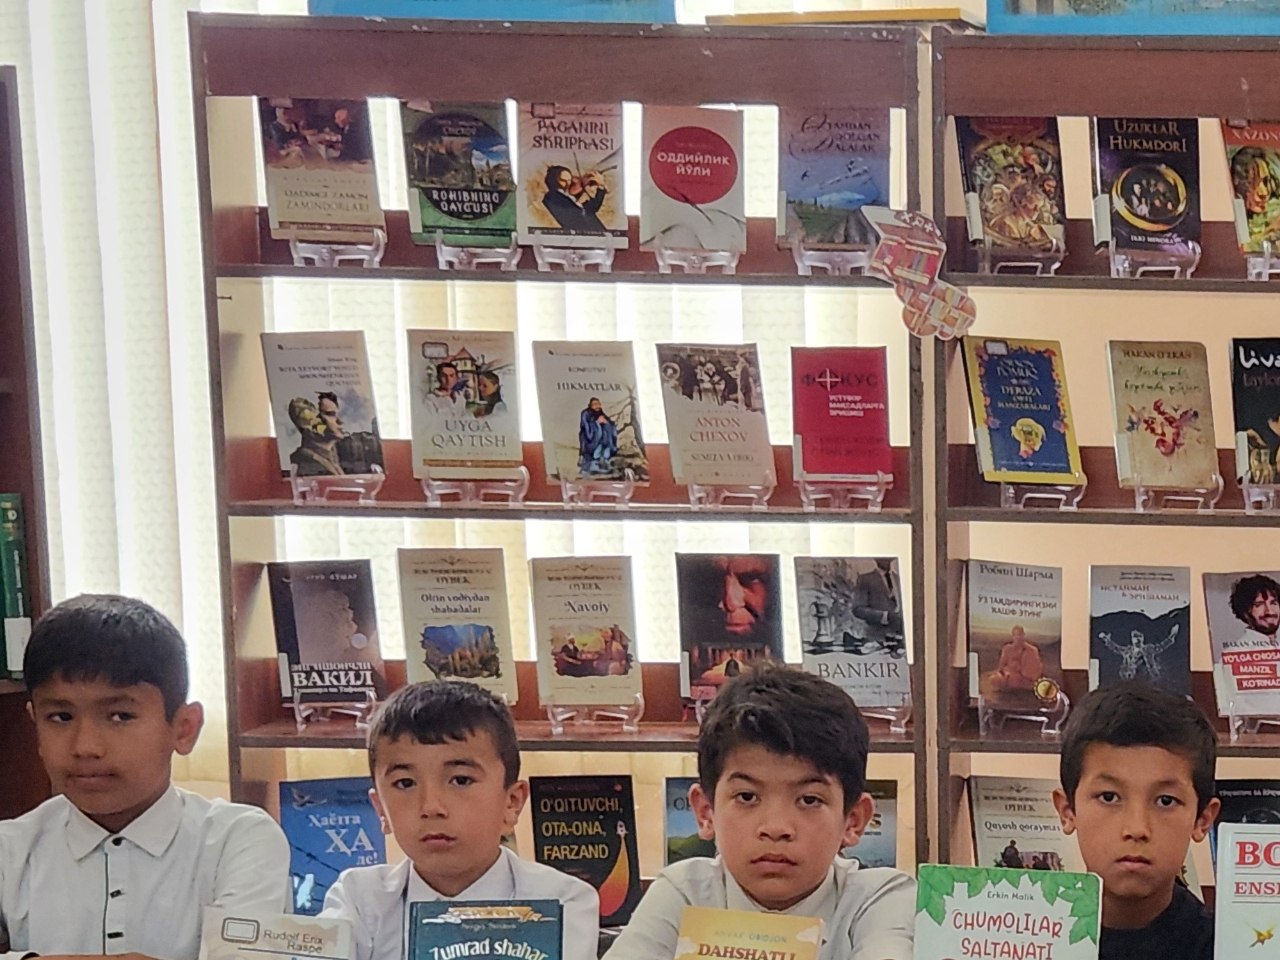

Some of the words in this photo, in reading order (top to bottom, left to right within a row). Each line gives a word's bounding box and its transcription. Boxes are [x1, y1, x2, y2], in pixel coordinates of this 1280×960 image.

[538, 120, 608, 136] PAGANINI
[1114, 119, 1180, 137] UZUKLAR
[532, 136, 614, 151] SKRIPKASI
[1109, 136, 1187, 153] HUKMDORI
[657, 152, 730, 166] ОДДИЙЛИК
[677, 165, 711, 177] ЙЎЛИ
[432, 190, 499, 203] ROHIBNING
[557, 382, 622, 392] HIKMATLAR
[444, 420, 493, 433] UYGA
[696, 417, 741, 428] ANTON
[431, 434, 507, 448] QAYTISH
[689, 431, 748, 443] CHEXOV
[980, 564, 1013, 576] Робин
[1016, 567, 1054, 580] Шарма
[818, 662, 900, 679] BANKIR
[1239, 664, 1273, 674] MANZIL
[293, 671, 375, 687] ВАКИЛ
[539, 797, 624, 813] O'QITUVCHI,
[541, 820, 607, 838] OTA-ONA,
[543, 845, 609, 860] FARZAND
[987, 890, 1009, 900] Erkin
[1012, 892, 1034, 901] Malik
[953, 911, 1063, 938] CHUMOLILAR
[264, 929, 300, 942] Rudolf
[287, 941, 323, 954] Raspe
